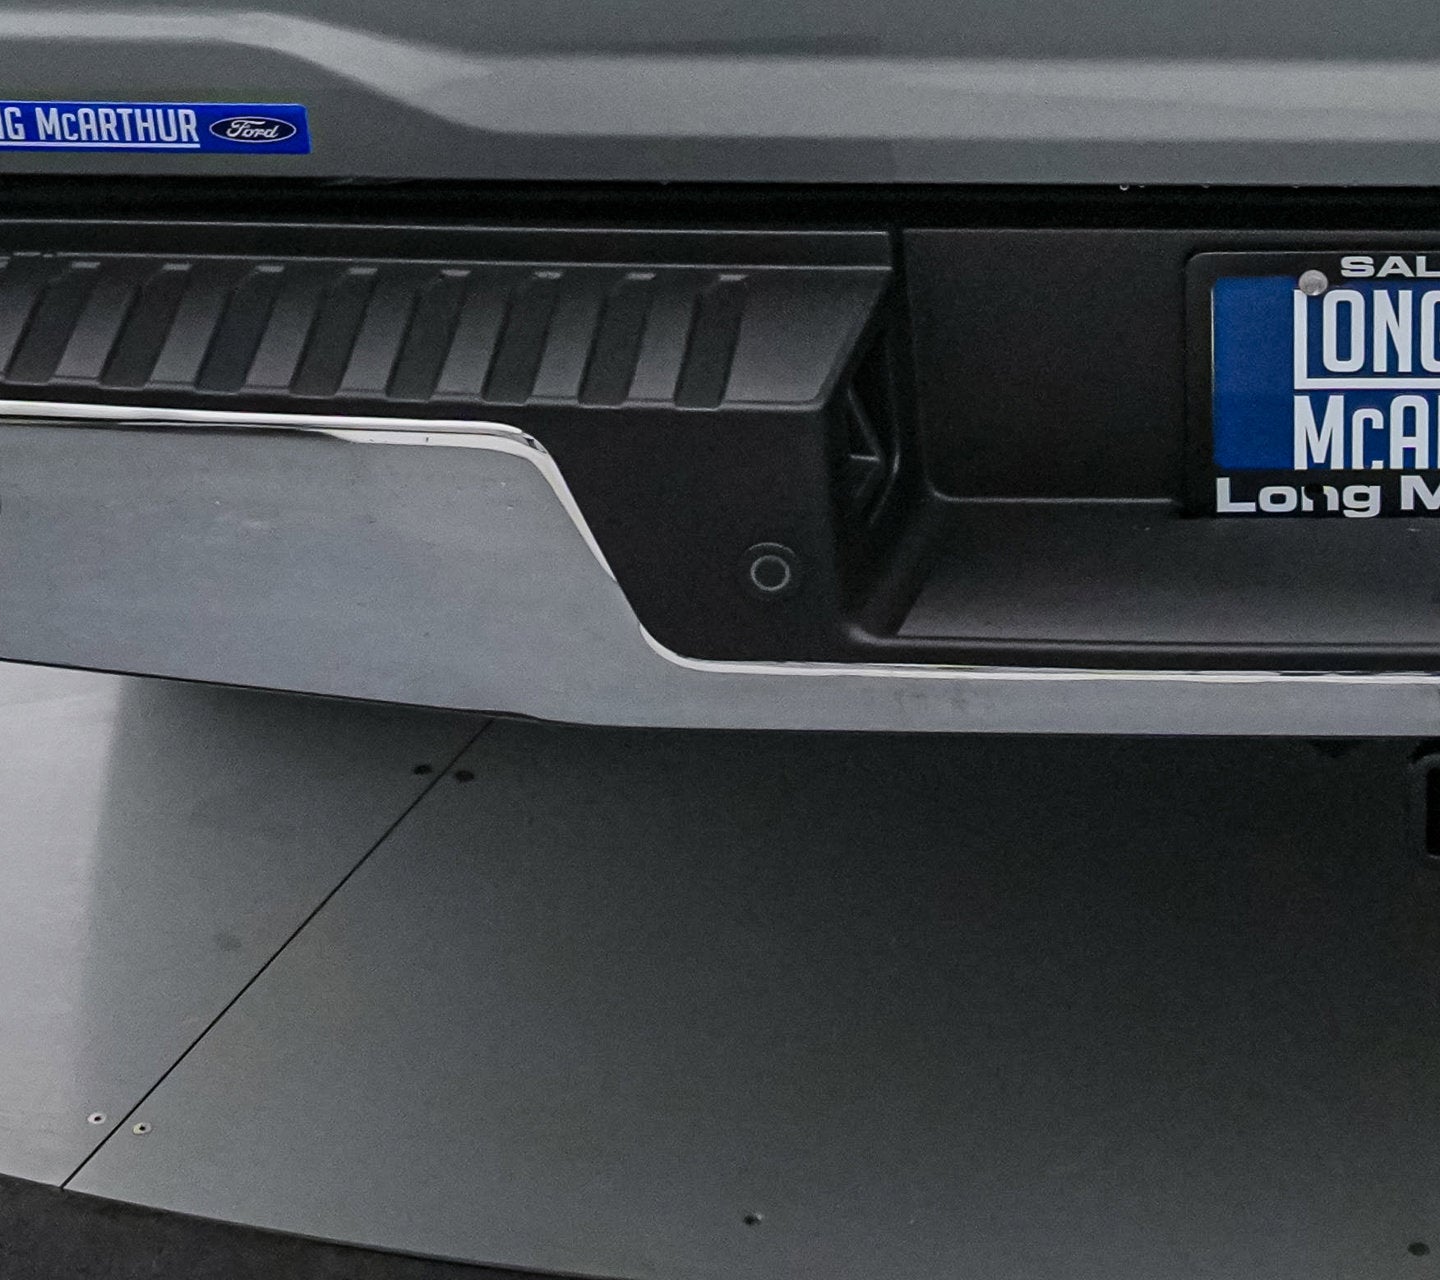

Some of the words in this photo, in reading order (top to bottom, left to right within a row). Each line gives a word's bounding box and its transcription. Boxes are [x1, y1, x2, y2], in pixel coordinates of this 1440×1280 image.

[34, 107, 201, 143] McARTHUR
[225, 118, 280, 140] Ford
[1215, 476, 1382, 518] Long
